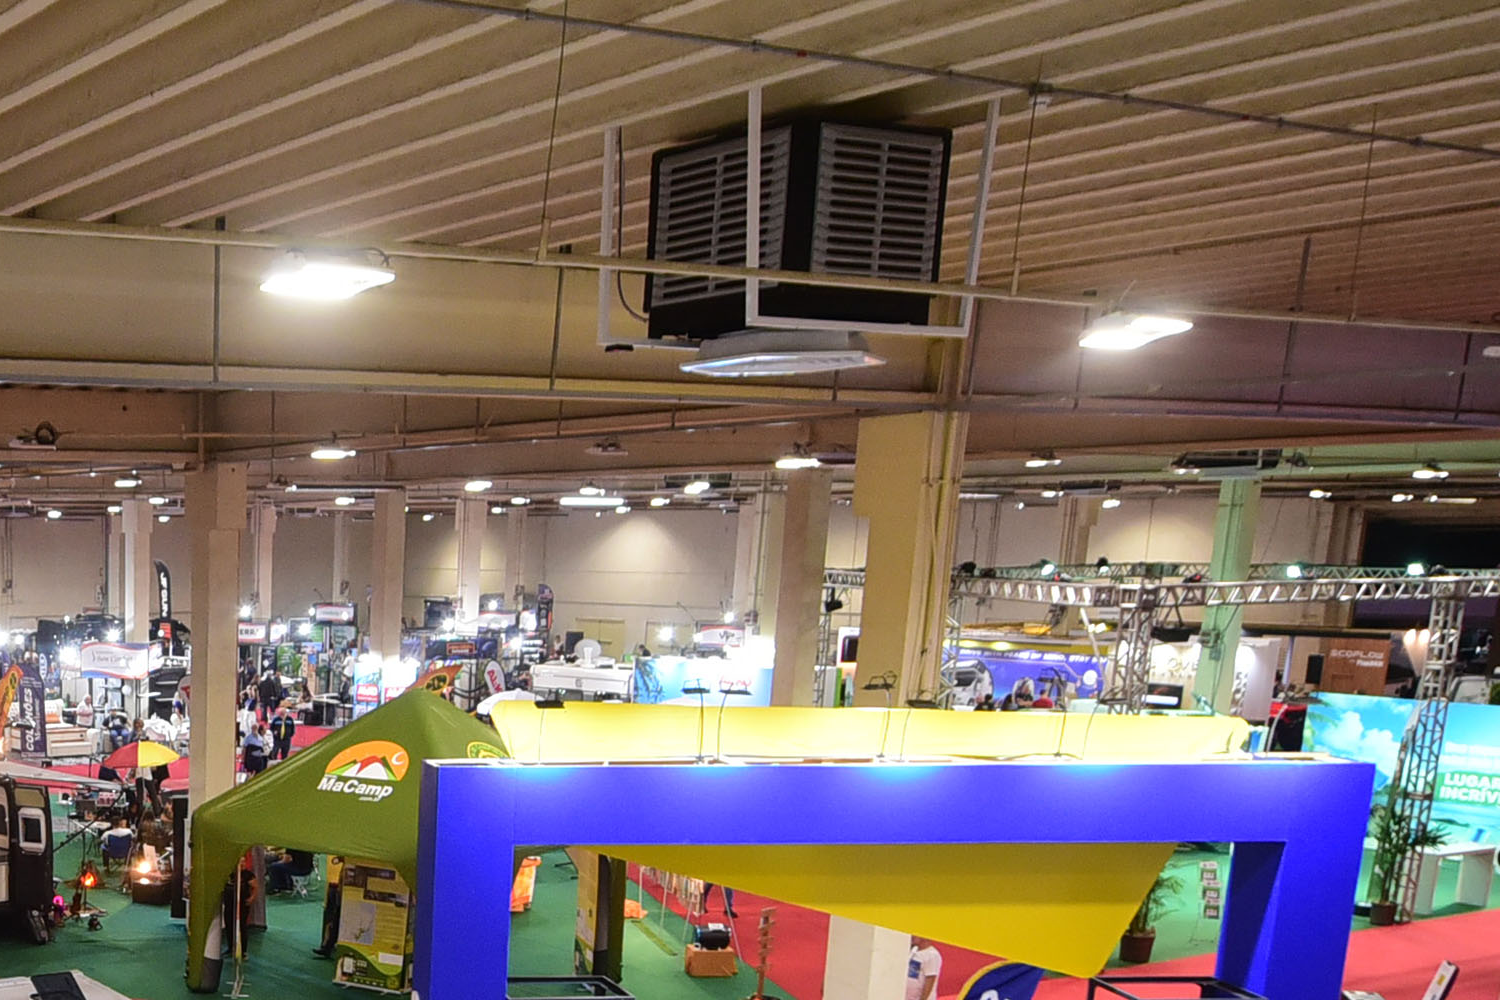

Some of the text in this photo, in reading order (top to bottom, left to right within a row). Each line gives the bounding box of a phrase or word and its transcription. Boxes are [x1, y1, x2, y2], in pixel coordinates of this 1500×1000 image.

[23, 688, 34, 752] COLHÕES
[317, 777, 394, 799] MaCamp
[1440, 786, 1500, 806] INCRÍV
